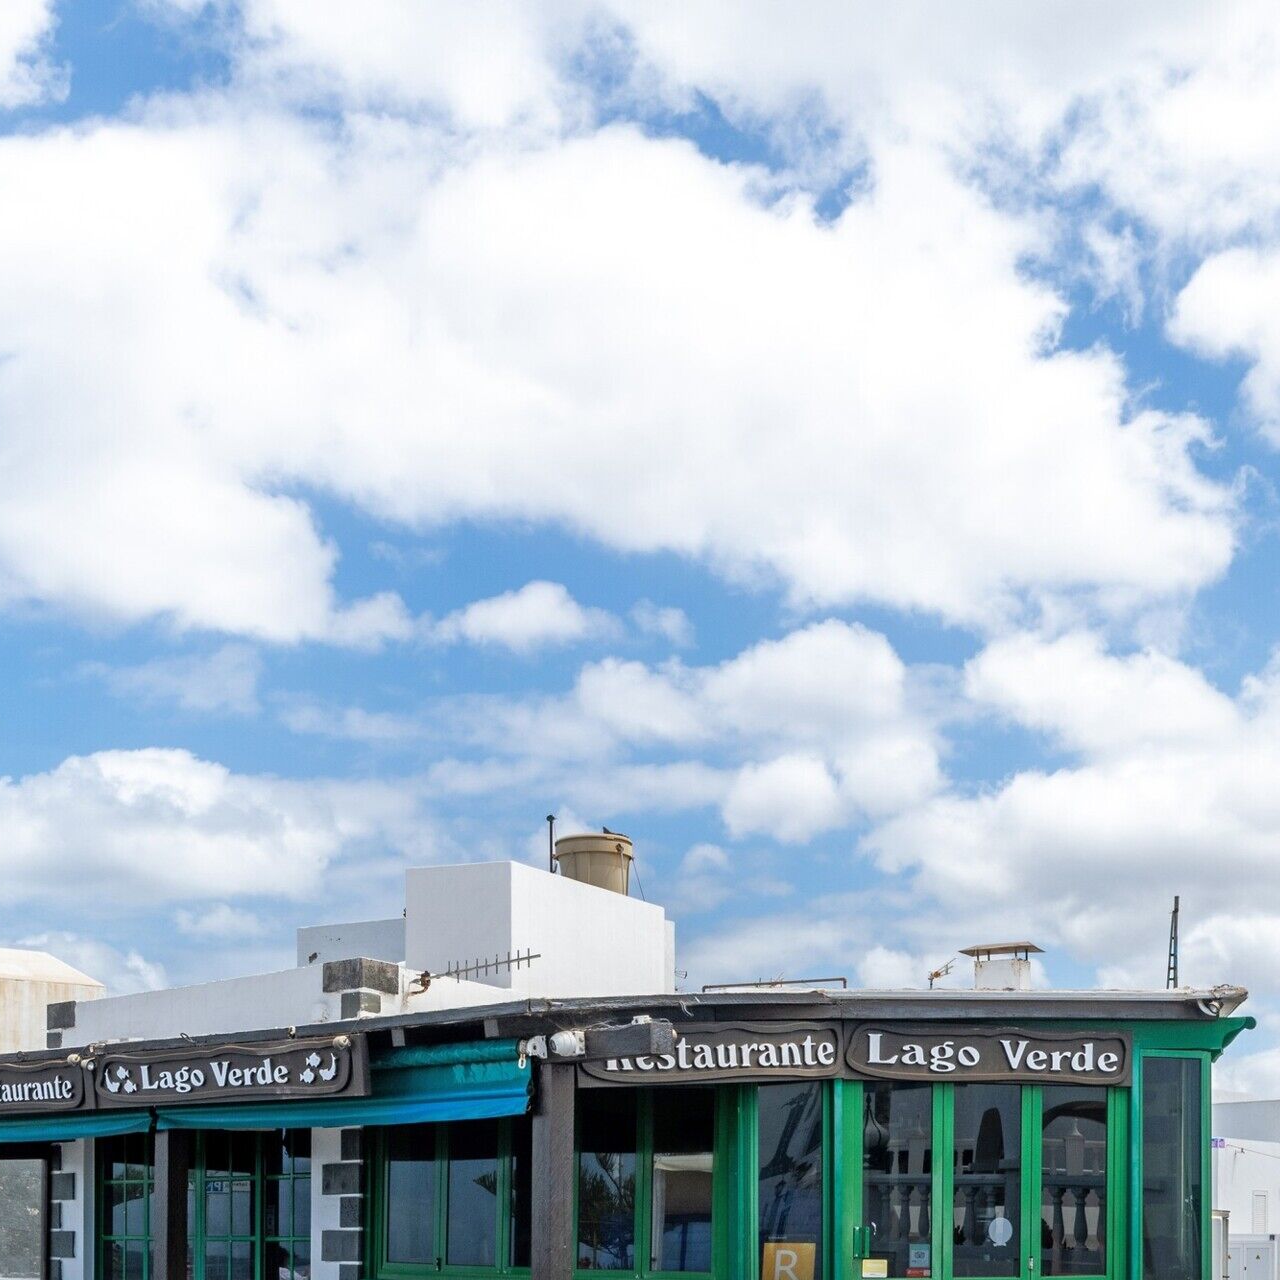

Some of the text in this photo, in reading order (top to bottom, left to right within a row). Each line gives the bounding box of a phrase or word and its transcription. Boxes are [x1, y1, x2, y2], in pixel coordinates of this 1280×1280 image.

[867, 1032, 981, 1073] Lago
[999, 1039, 1120, 1073] Verde
[141, 1066, 205, 1093] Lago
[210, 1060, 289, 1088] Verde
